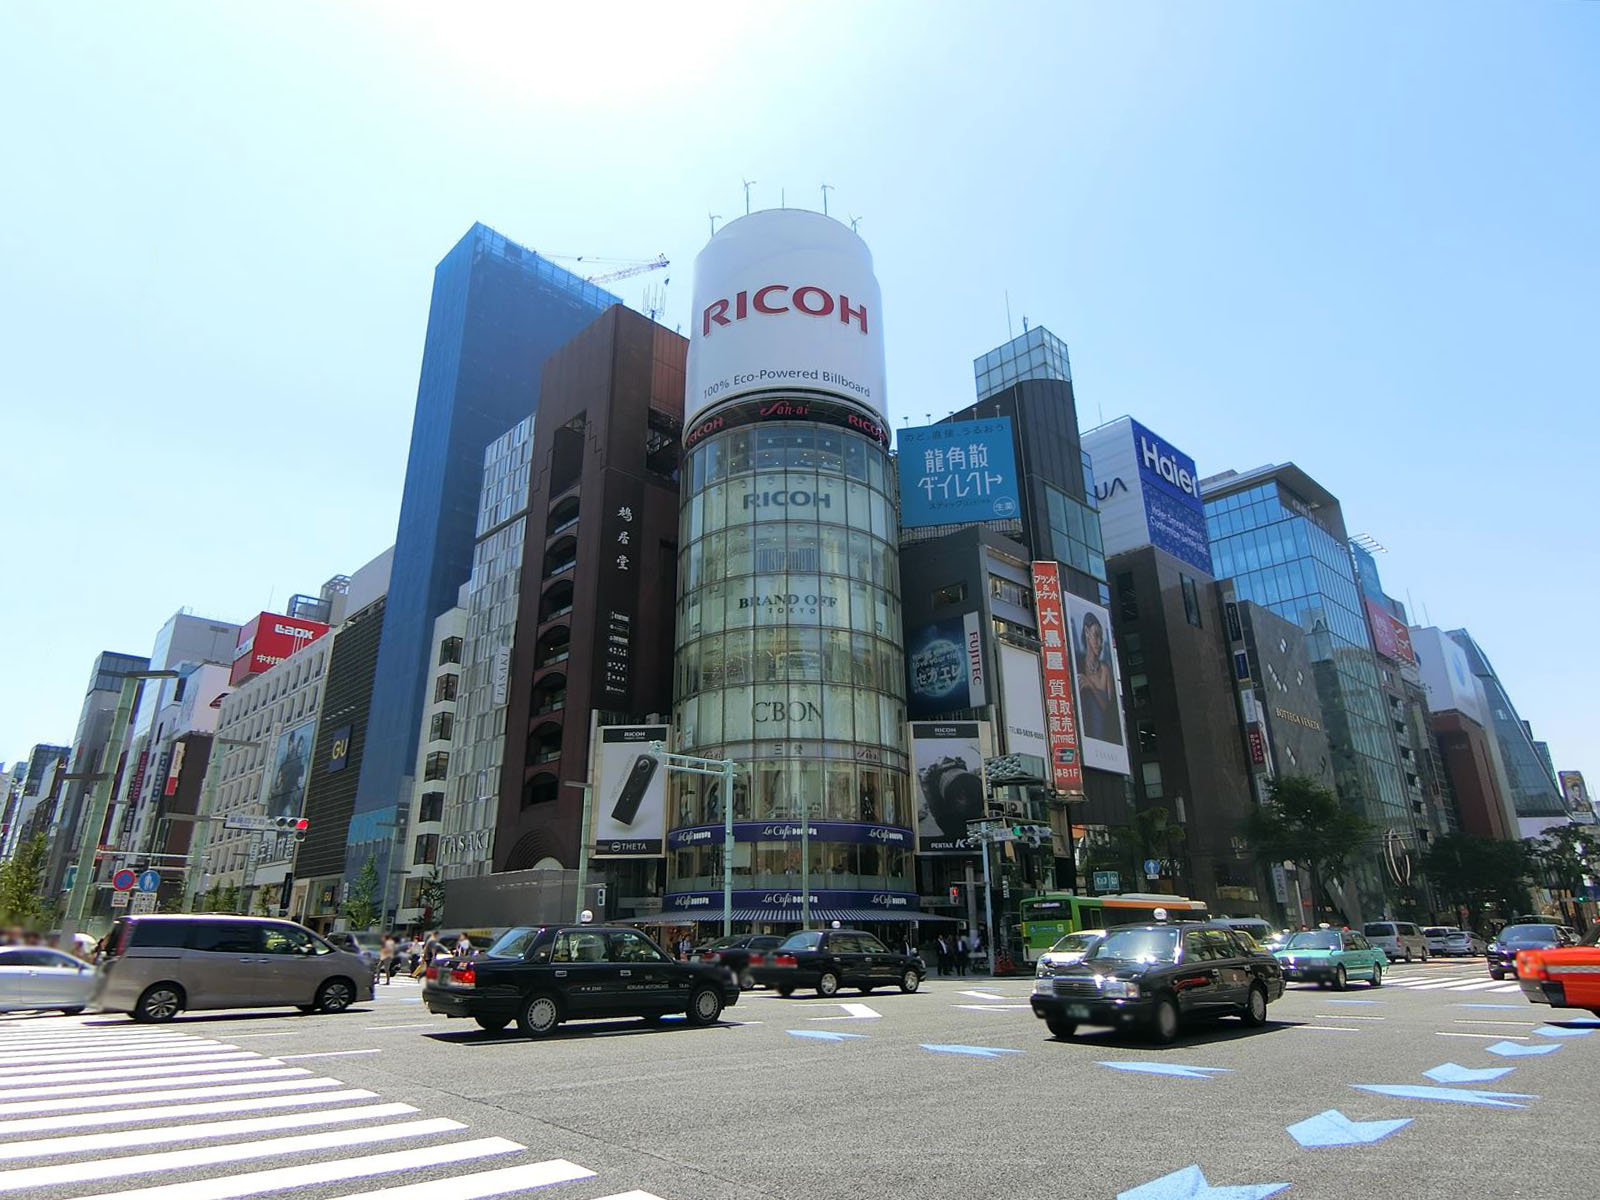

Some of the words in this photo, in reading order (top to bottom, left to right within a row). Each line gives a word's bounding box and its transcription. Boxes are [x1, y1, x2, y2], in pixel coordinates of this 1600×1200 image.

[703, 284, 869, 337] RICOH
[703, 379, 731, 399] 100%
[733, 368, 819, 386] Eco-Powered
[822, 371, 871, 398] Billboard
[687, 417, 724, 445] RICOH
[924, 442, 989, 474] 龍角散
[1140, 436, 1199, 498] Haier
[743, 490, 831, 510] RICOH
[917, 470, 1003, 501] ダイレクト
[616, 506, 633, 571] 鳩居堂
[739, 594, 800, 609] BRAND
[804, 594, 838, 609] OFF
[767, 607, 816, 615] TOKYO
[1041, 607, 1065, 671] 大黒屋
[968, 631, 982, 686] FUJITEC
[332, 738, 349, 760] GU
[440, 830, 492, 856] TASAKI
[621, 843, 647, 851] THETA
